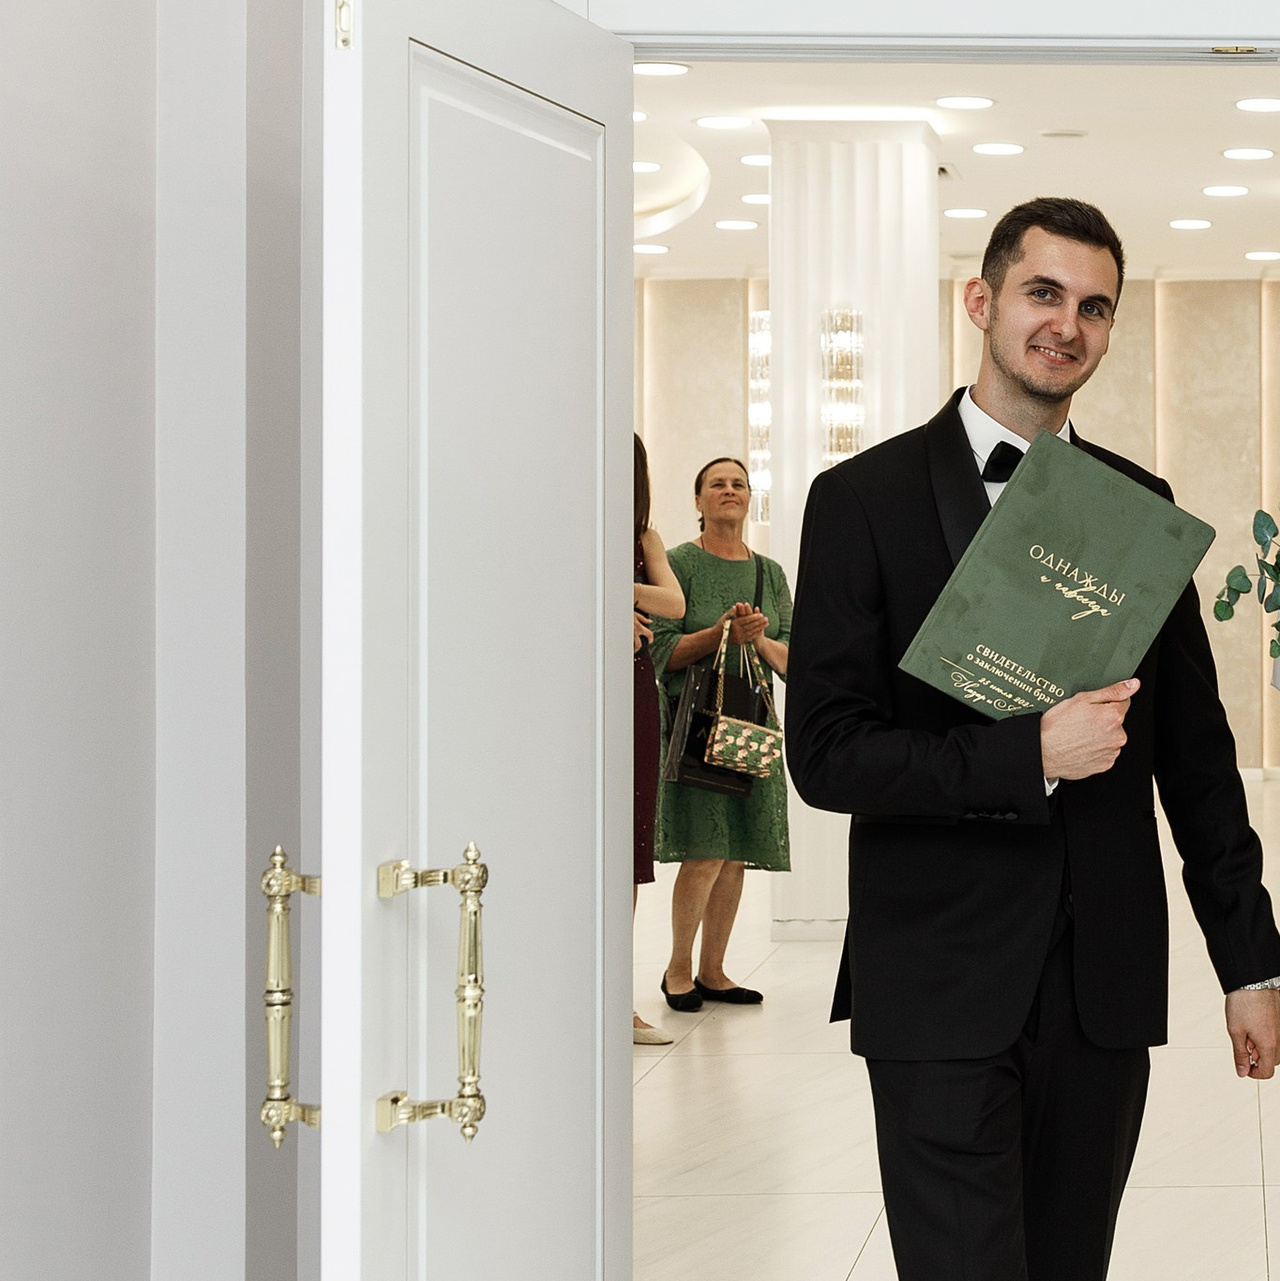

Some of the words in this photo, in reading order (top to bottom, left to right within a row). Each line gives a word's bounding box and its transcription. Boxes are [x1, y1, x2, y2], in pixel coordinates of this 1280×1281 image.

[1029, 544, 1126, 606] ОДНАЖДЫ
[1040, 575, 1052, 583] и
[1054, 582, 1111, 620] навсегда
[966, 653, 973, 662] о
[973, 655, 1033, 694] заключении
[1033, 688, 1057, 705] брак
[975, 644, 1065, 698] СВИДЕТЕЛЬСТВО
[978, 677, 991, 686] 25
